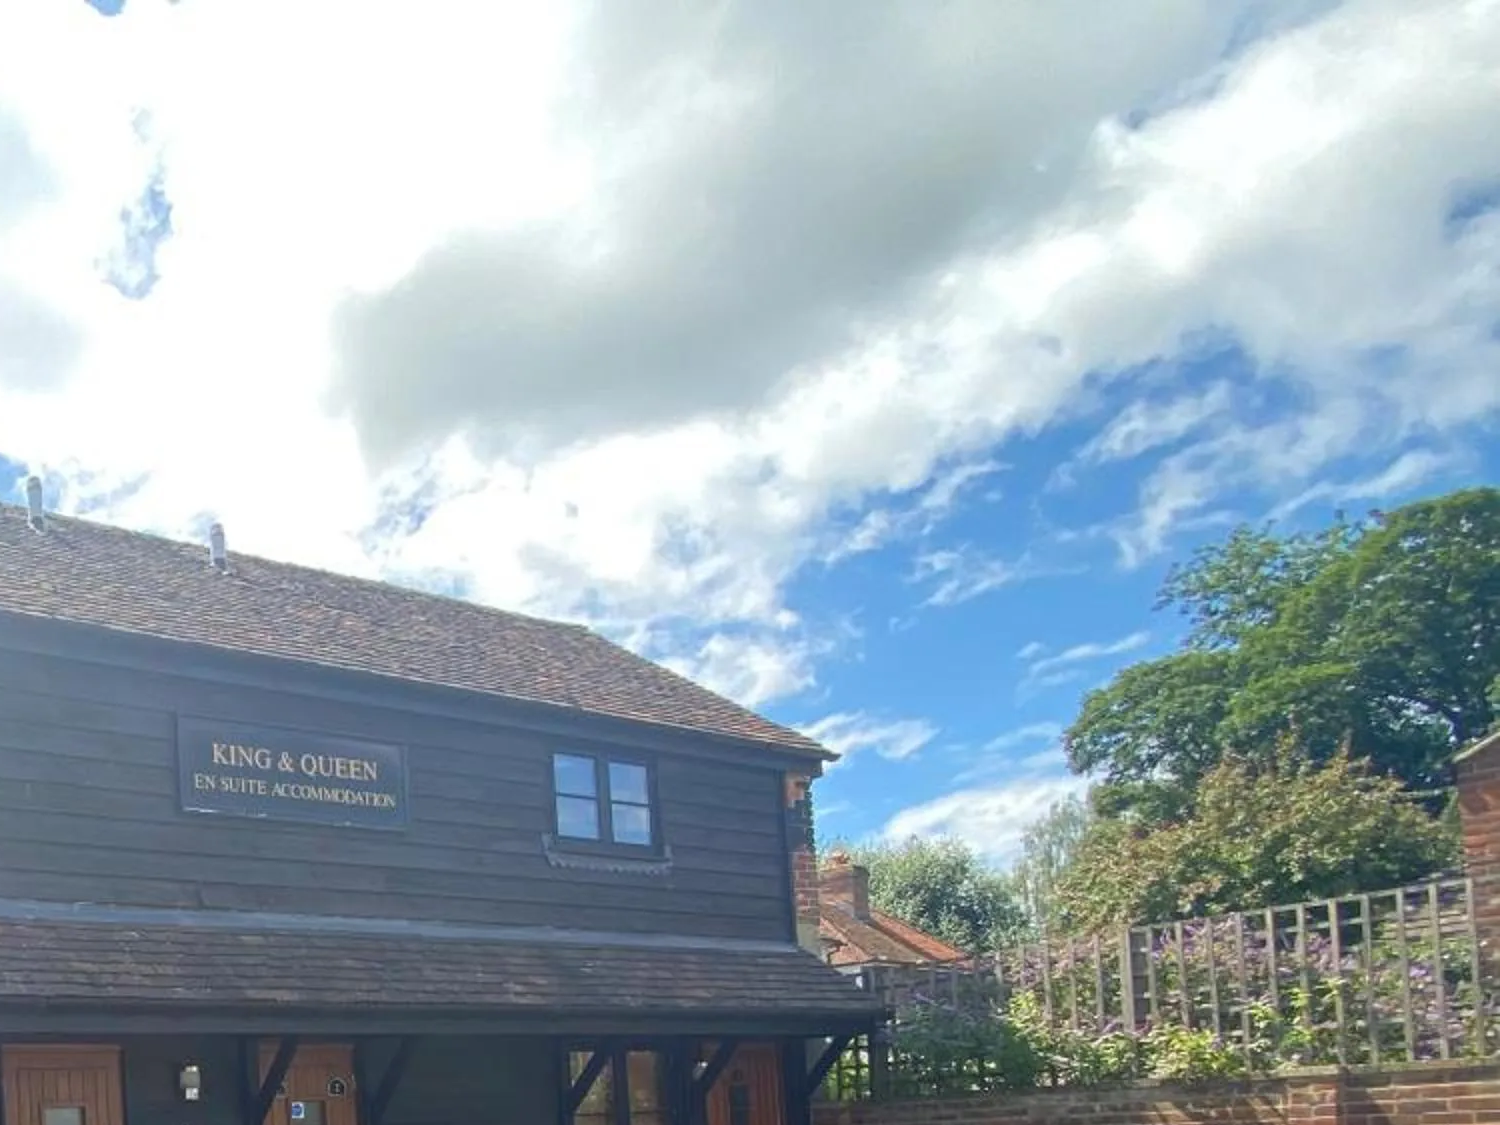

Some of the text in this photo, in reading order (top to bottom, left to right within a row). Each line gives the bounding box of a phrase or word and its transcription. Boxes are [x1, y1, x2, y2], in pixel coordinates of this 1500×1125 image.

[212, 743, 377, 781] KING & QUEEN
[195, 773, 396, 808] EN SUITE ACCOMMODATION
